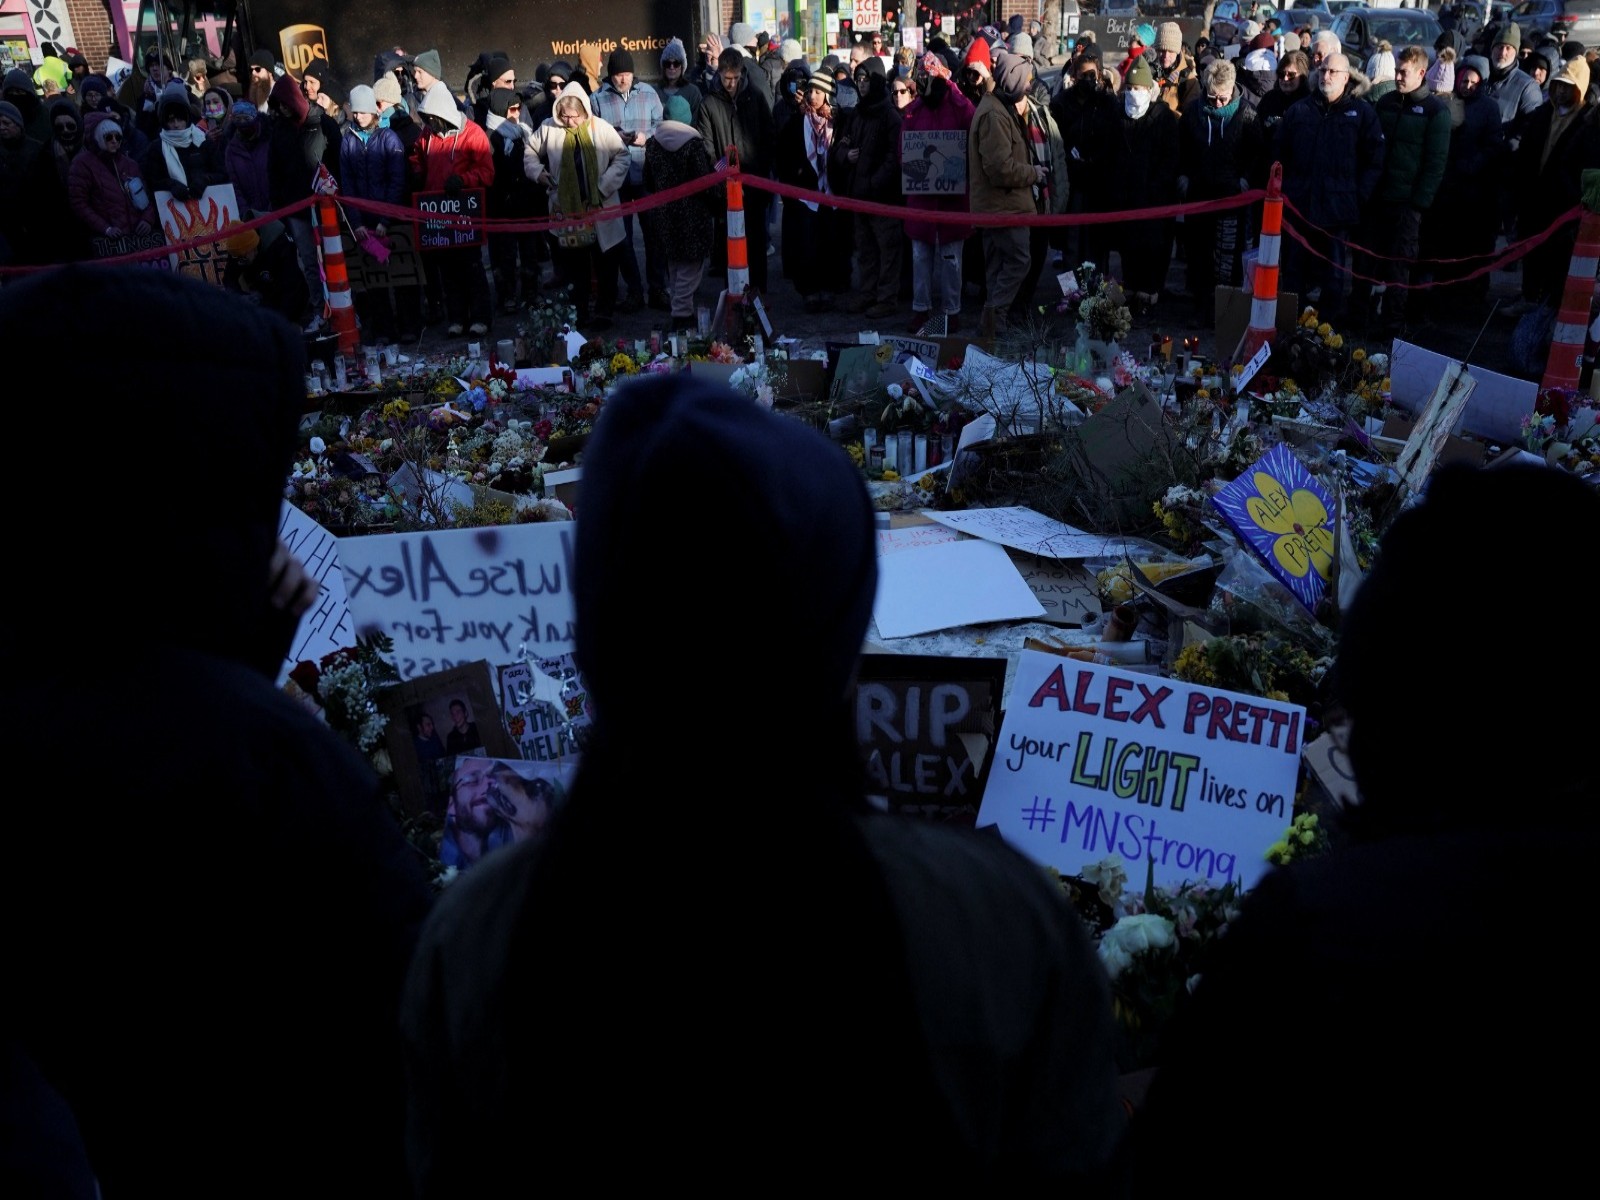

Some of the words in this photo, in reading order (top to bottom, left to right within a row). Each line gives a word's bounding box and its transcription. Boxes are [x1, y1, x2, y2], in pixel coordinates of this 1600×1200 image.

[856, 0, 879, 12] ICE
[856, 14, 880, 26] OUT!
[1106, 18, 1127, 34] Black
[905, 179, 930, 191] ICE
[935, 178, 959, 191] OUT
[420, 200, 437, 213] no
[440, 199, 461, 214] one
[467, 196, 478, 209] is
[92, 232, 164, 257] THINGS
[454, 228, 475, 245] land
[884, 338, 938, 359] STICE
[1254, 486, 1290, 526] ALEX
[855, 682, 971, 748] RIP
[1028, 663, 1174, 730] ALEX
[1183, 692, 1301, 754] PRETTI
[866, 748, 972, 797] ALEX
[1006, 732, 1070, 772] your
[1070, 731, 1201, 812] LIGHT
[1200, 767, 1249, 810] lives
[1255, 790, 1285, 819] on
[1020, 795, 1237, 884] #MNStrong
